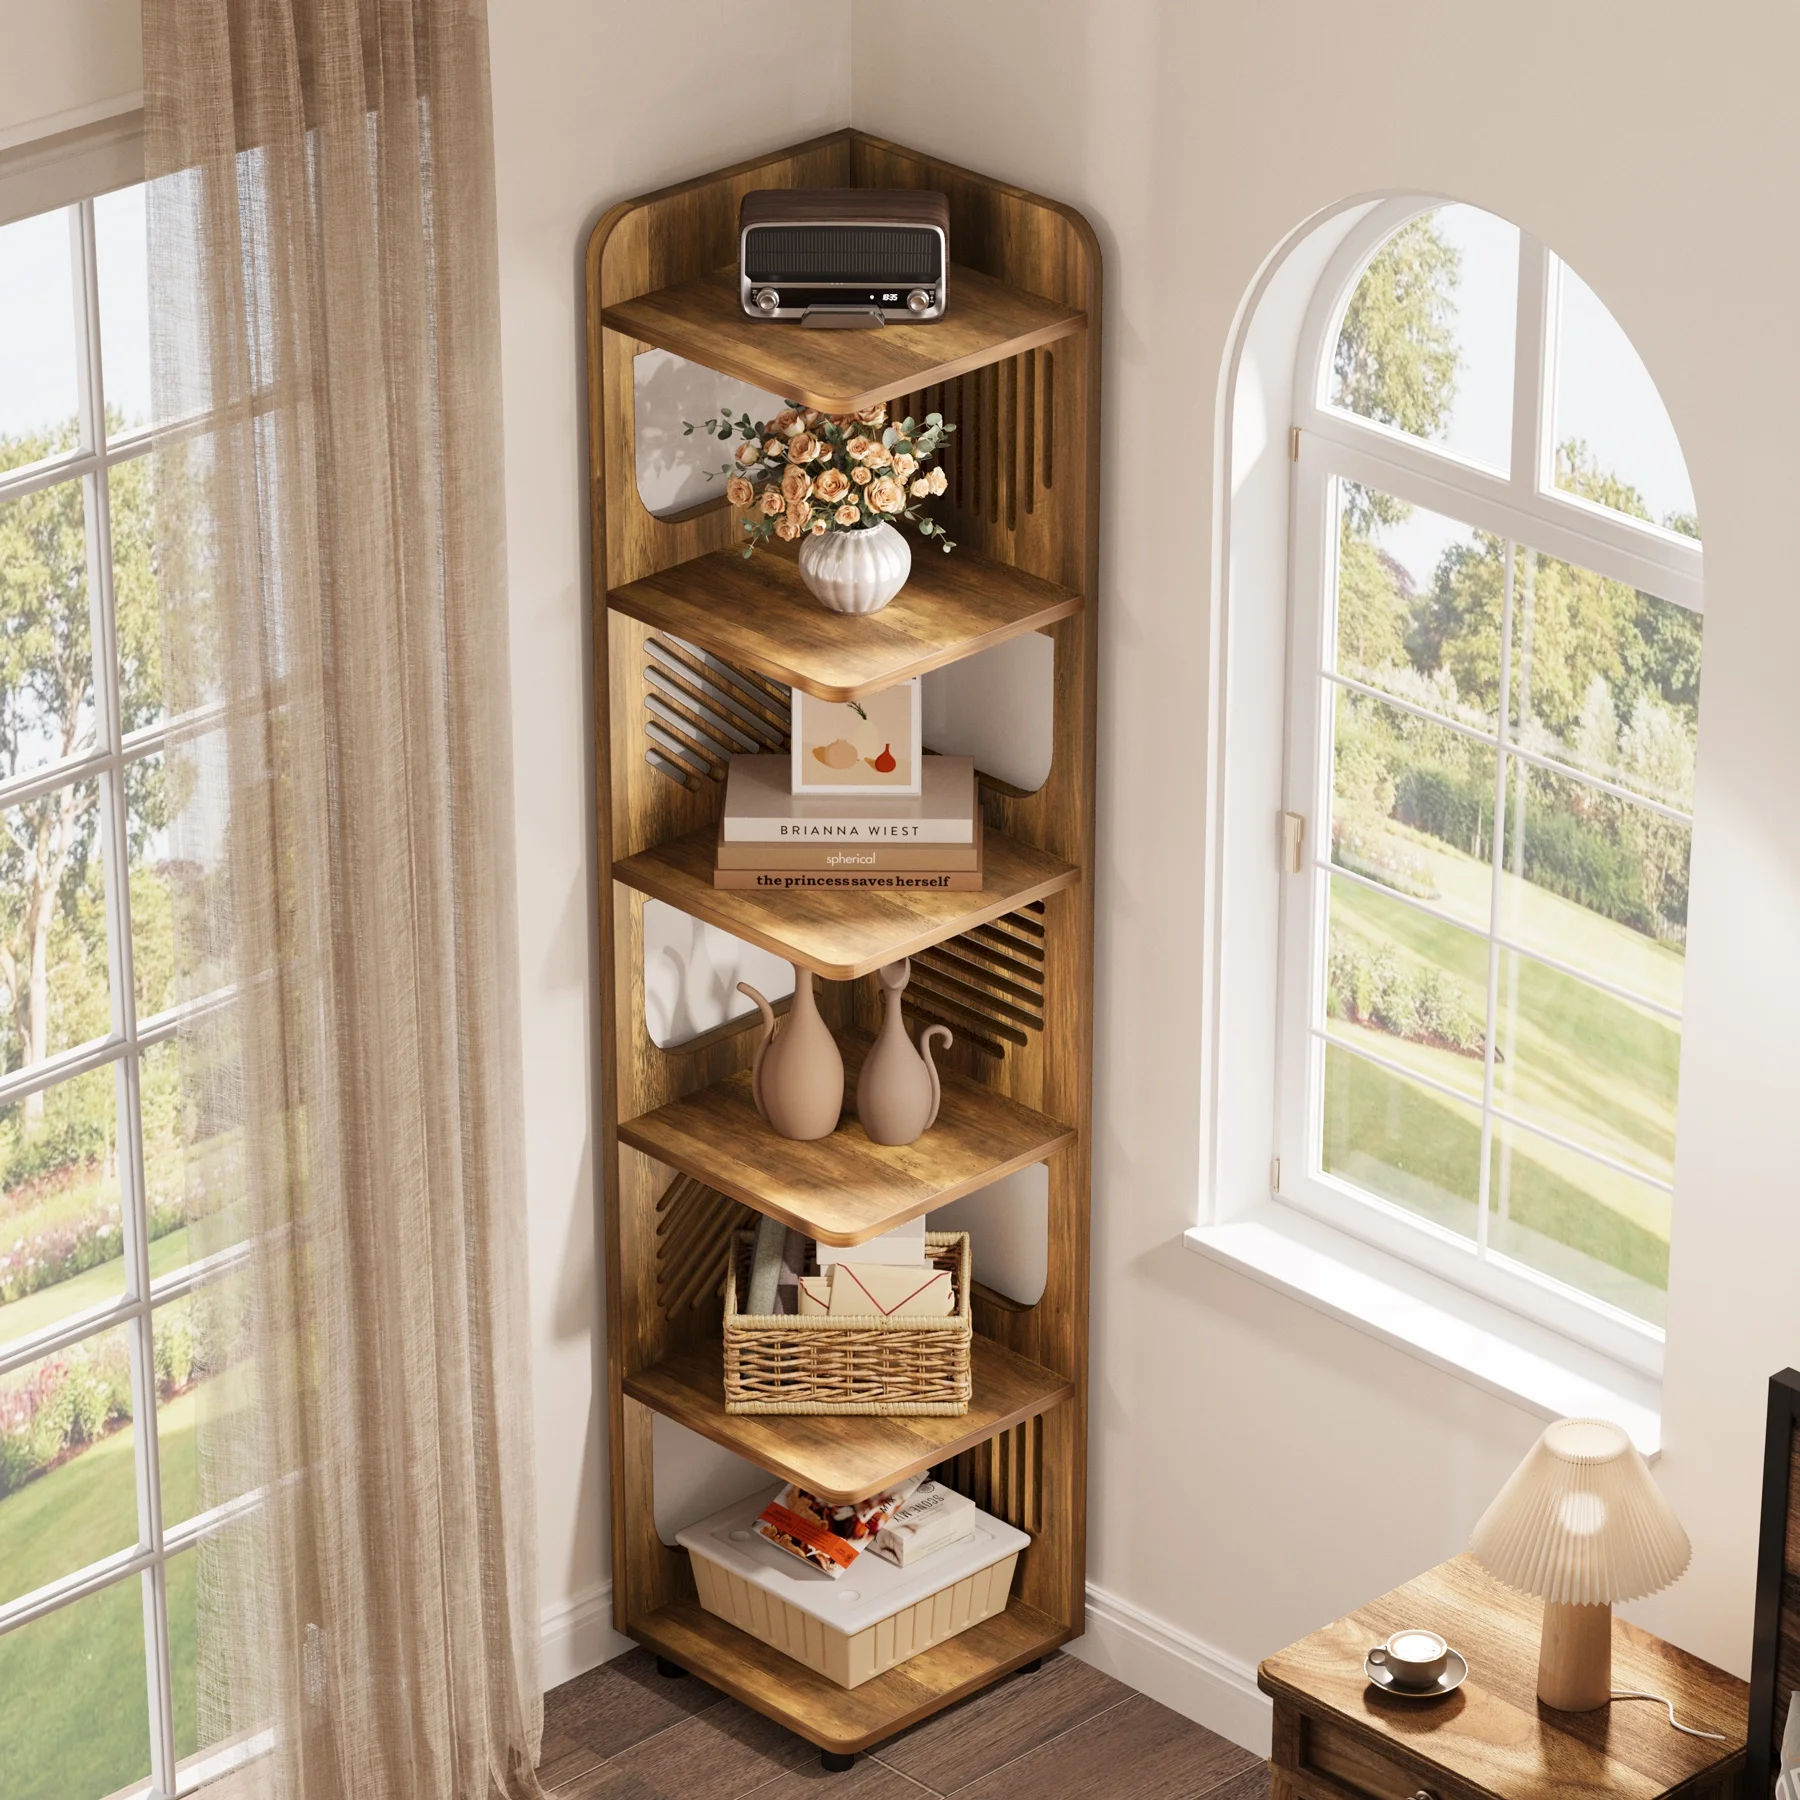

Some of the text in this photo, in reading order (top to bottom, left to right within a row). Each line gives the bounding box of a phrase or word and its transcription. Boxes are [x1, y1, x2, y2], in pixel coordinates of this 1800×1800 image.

[780, 825, 920, 837] BRIANNA WIEST
[826, 852, 876, 867] spherical
[756, 875, 950, 889] the princess saves herself
[879, 1495, 897, 1514] MIX
[910, 1494, 944, 1513] SCONE
[892, 1509, 913, 1523] MIX
